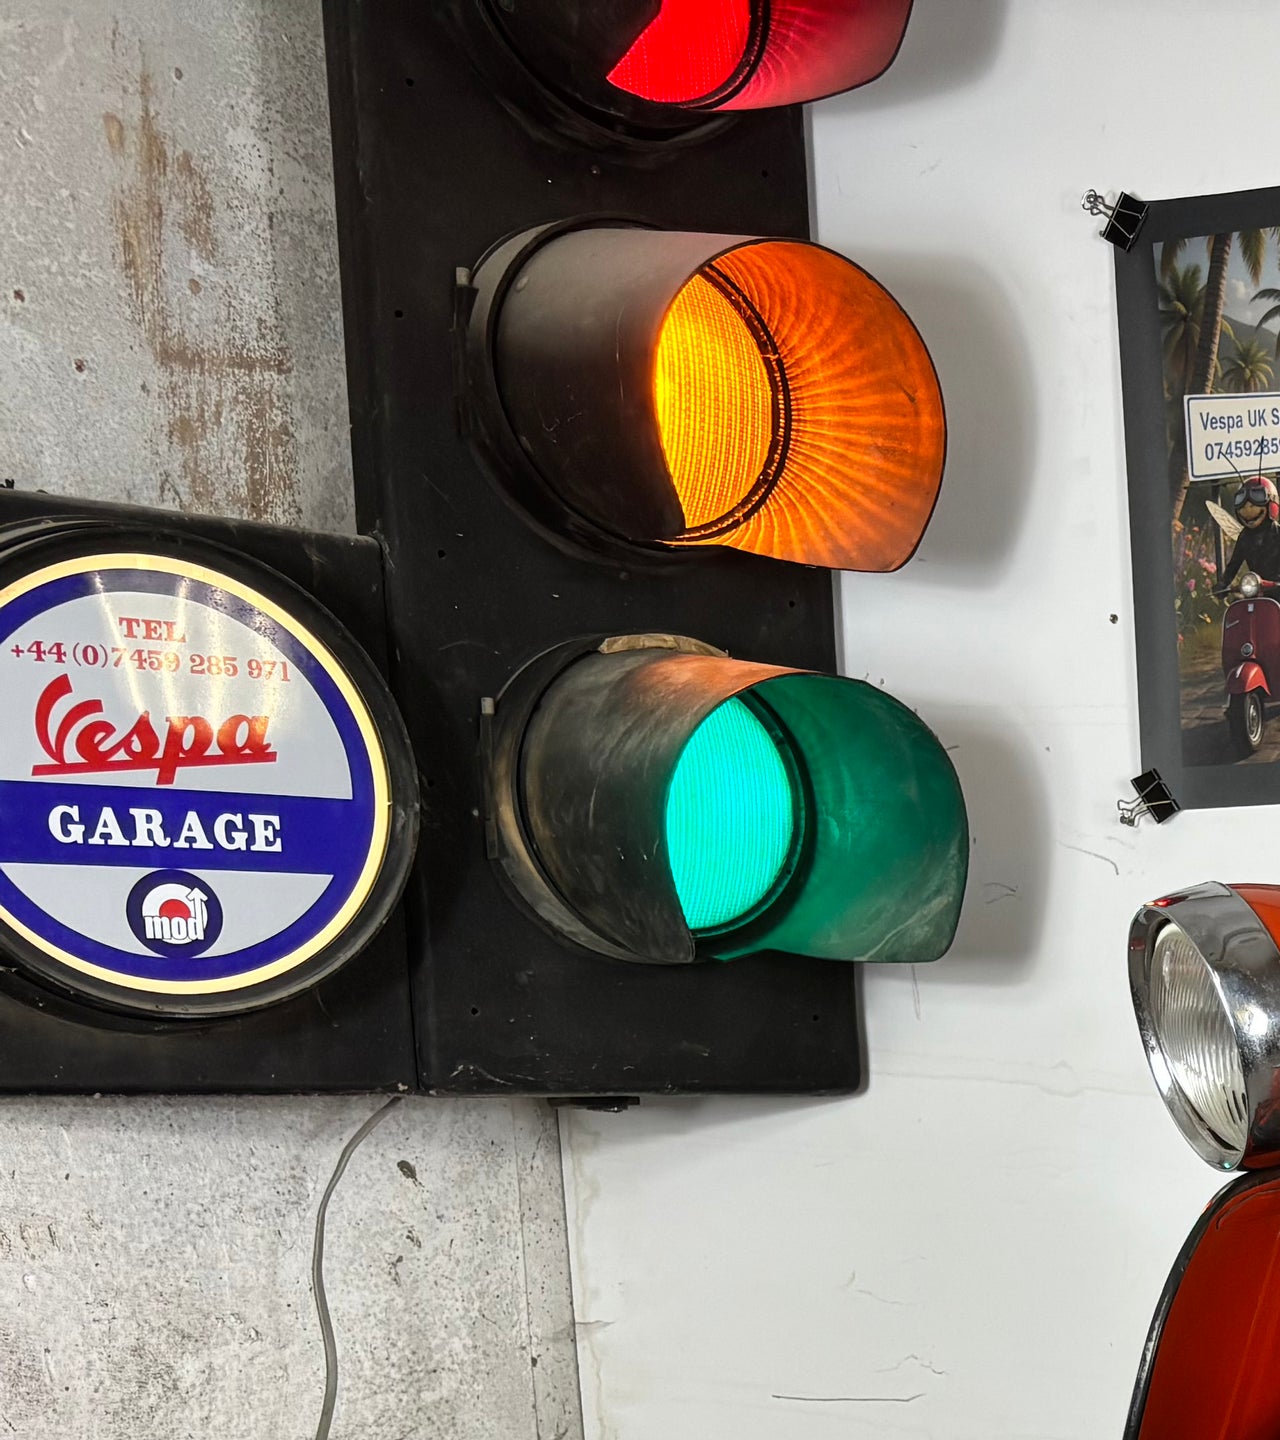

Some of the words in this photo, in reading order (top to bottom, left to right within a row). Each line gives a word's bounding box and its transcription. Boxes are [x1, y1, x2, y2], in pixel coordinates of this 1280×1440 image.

[1199, 411, 1244, 434] Vespa
[1247, 408, 1268, 427] UK
[118, 617, 187, 643] TEL
[189, 654, 239, 677] 285
[247, 659, 291, 682] 971
[32, 673, 277, 785] Vespa
[48, 804, 283, 853] GARAGE
[144, 888, 207, 941] mod
